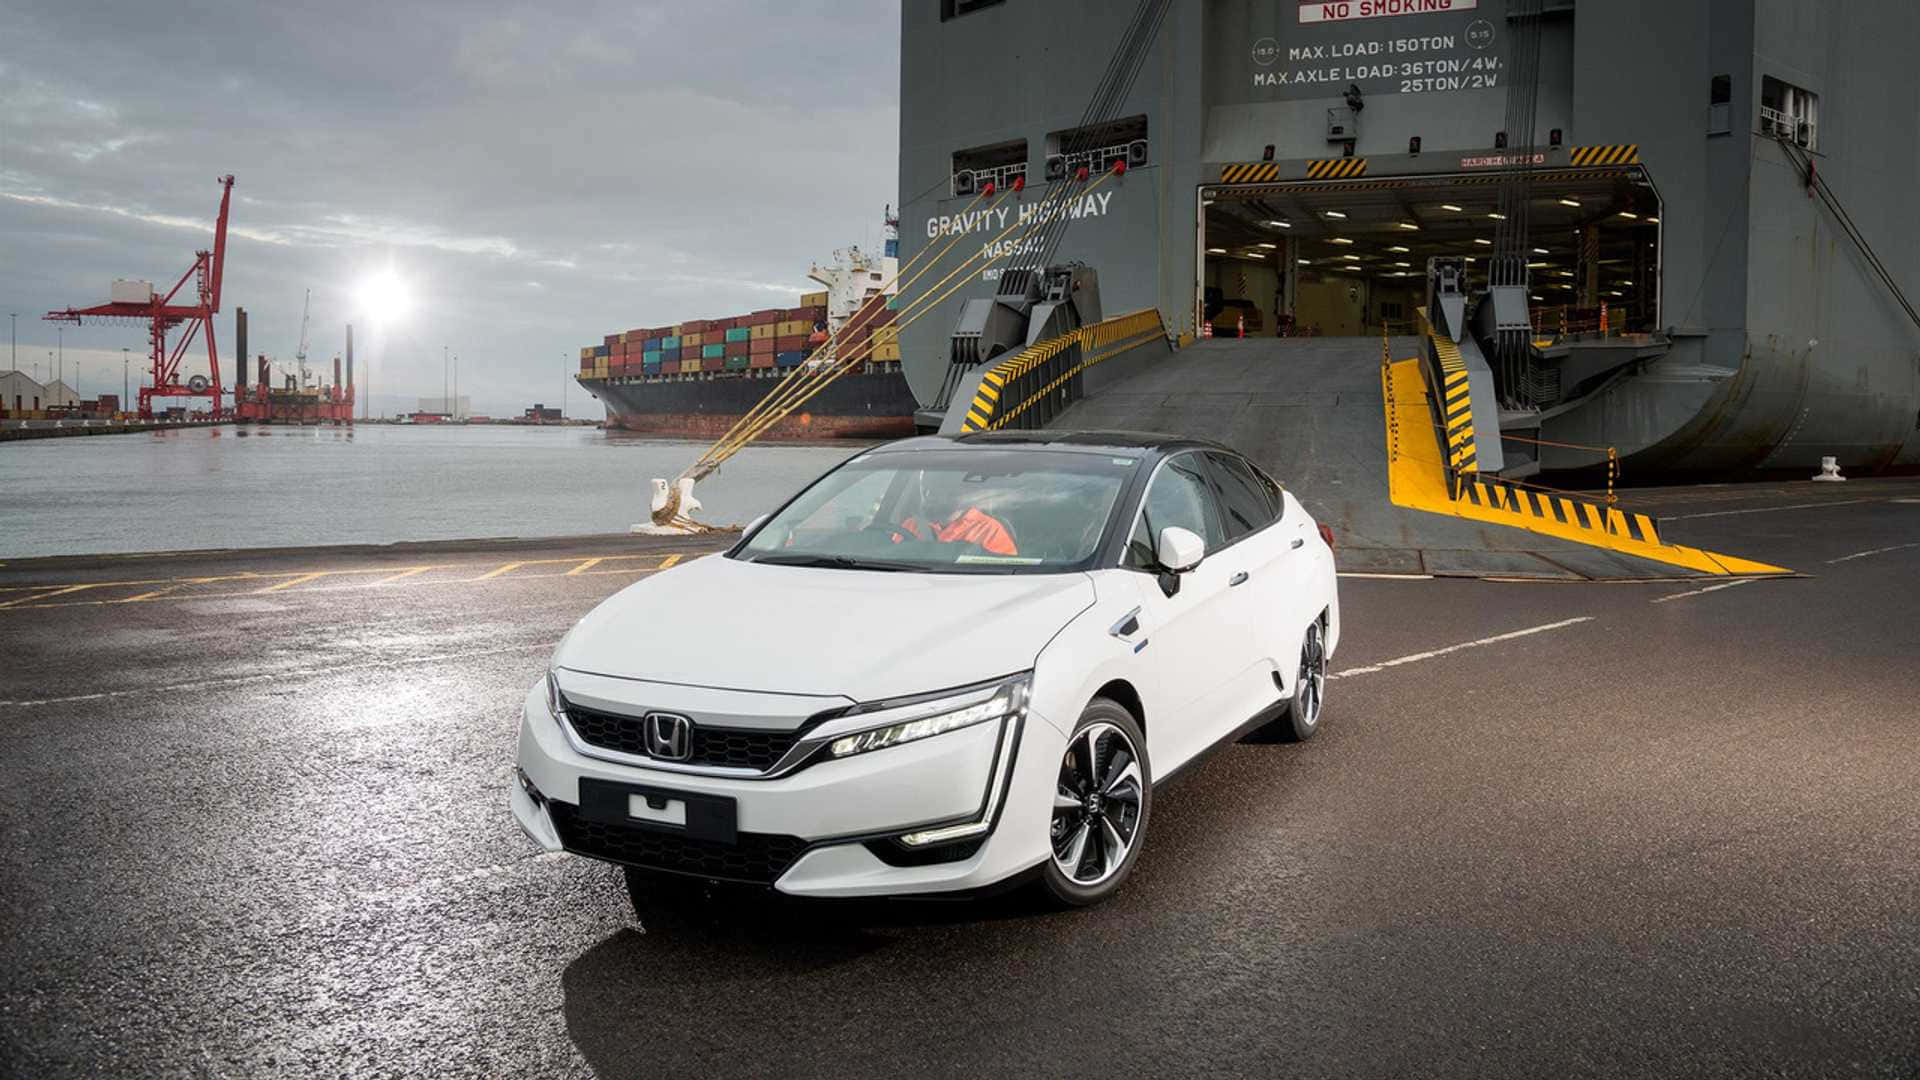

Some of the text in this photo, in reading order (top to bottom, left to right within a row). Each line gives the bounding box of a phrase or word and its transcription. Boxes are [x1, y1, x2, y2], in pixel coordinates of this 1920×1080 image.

[1323, 0, 1452, 19] NO SMOKING
[1401, 74, 1498, 93] 25TON/2W
[927, 206, 1009, 238] GRAVITY
